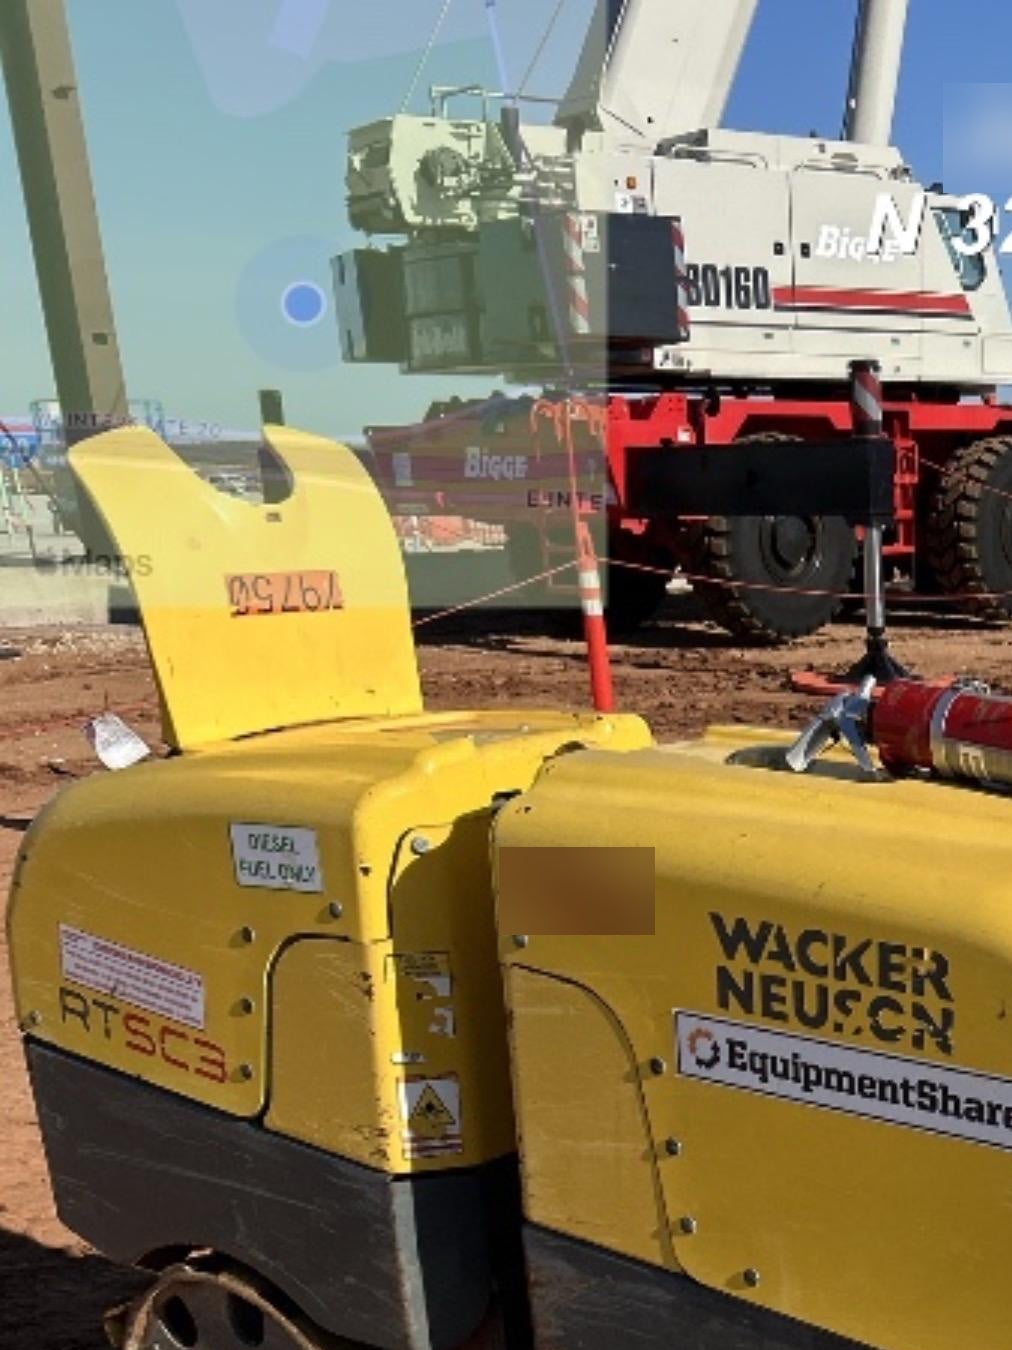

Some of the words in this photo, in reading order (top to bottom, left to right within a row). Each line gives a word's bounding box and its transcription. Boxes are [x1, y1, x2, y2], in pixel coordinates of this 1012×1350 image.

[247, 832, 301, 855] DIESEL
[239, 857, 277, 880] FUEL
[708, 910, 956, 1003] WACKER
